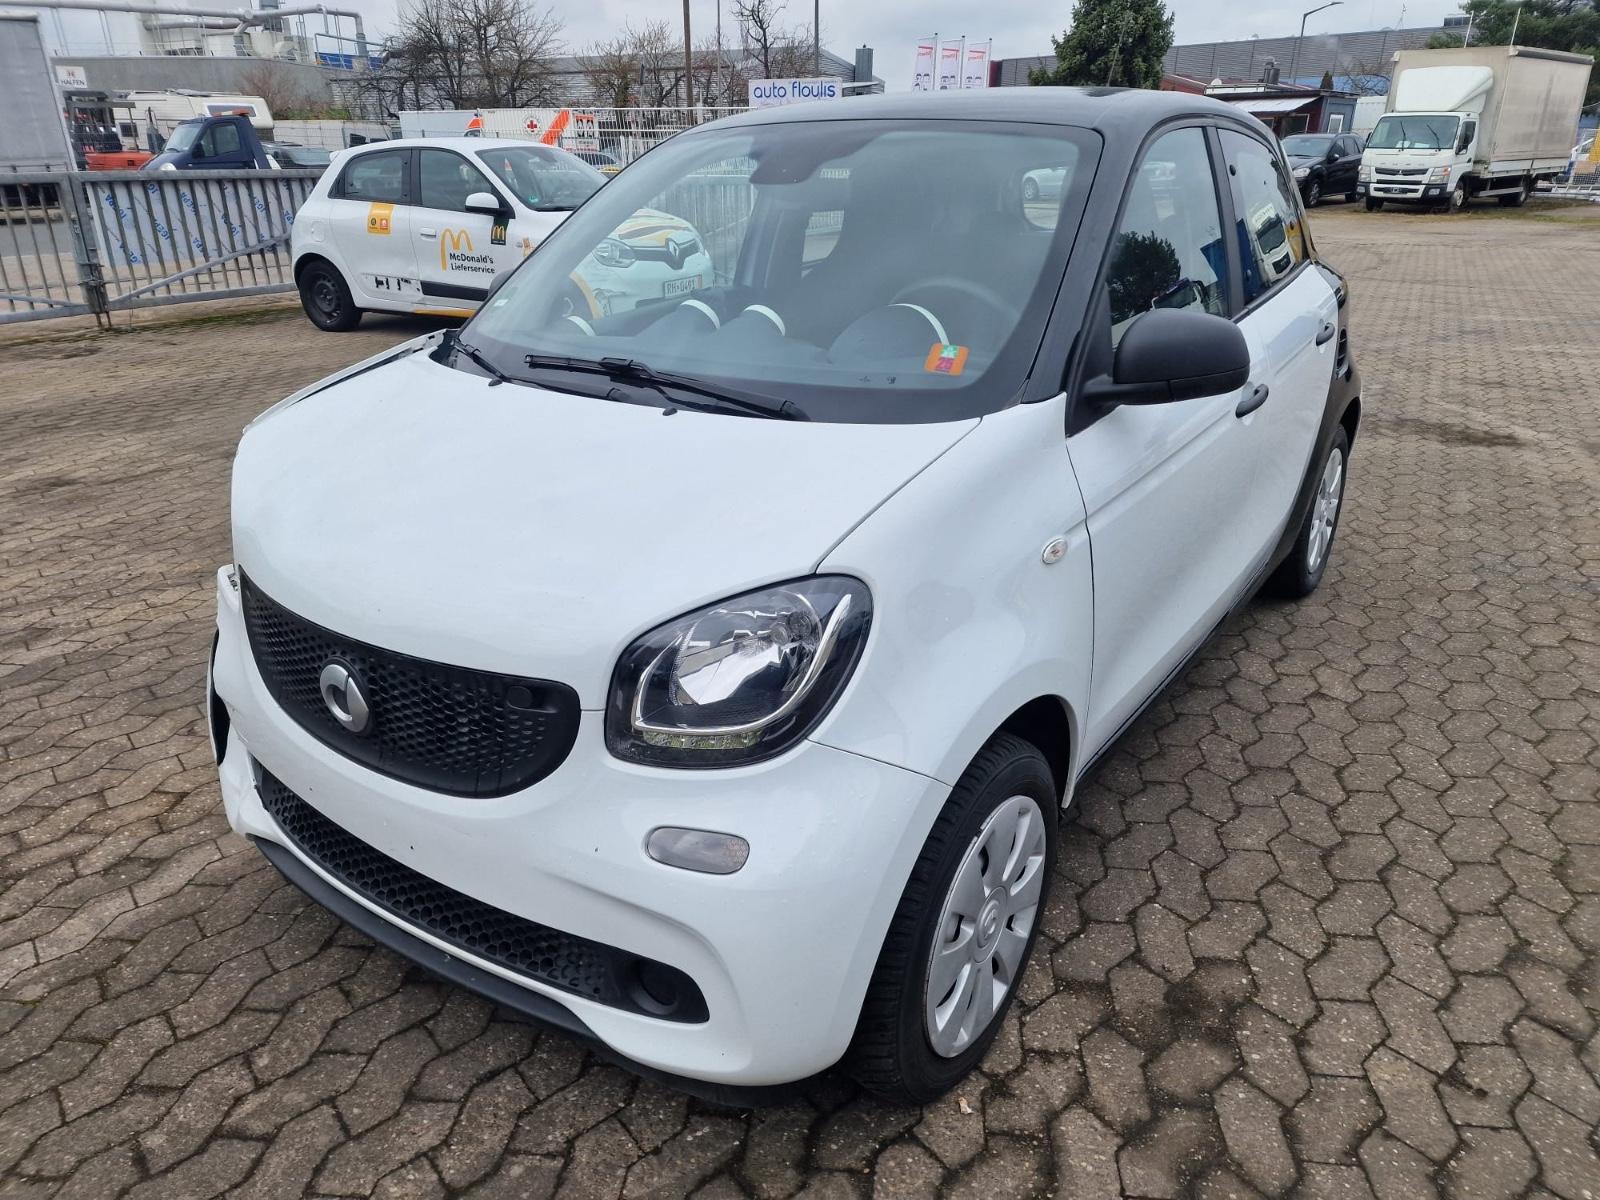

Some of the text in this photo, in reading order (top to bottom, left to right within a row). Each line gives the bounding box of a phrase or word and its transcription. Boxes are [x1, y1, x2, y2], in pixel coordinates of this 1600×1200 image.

[753, 81, 836, 98] auto floulis
[449, 252, 494, 265] McDonald's
[450, 262, 496, 275] Lieferservice
